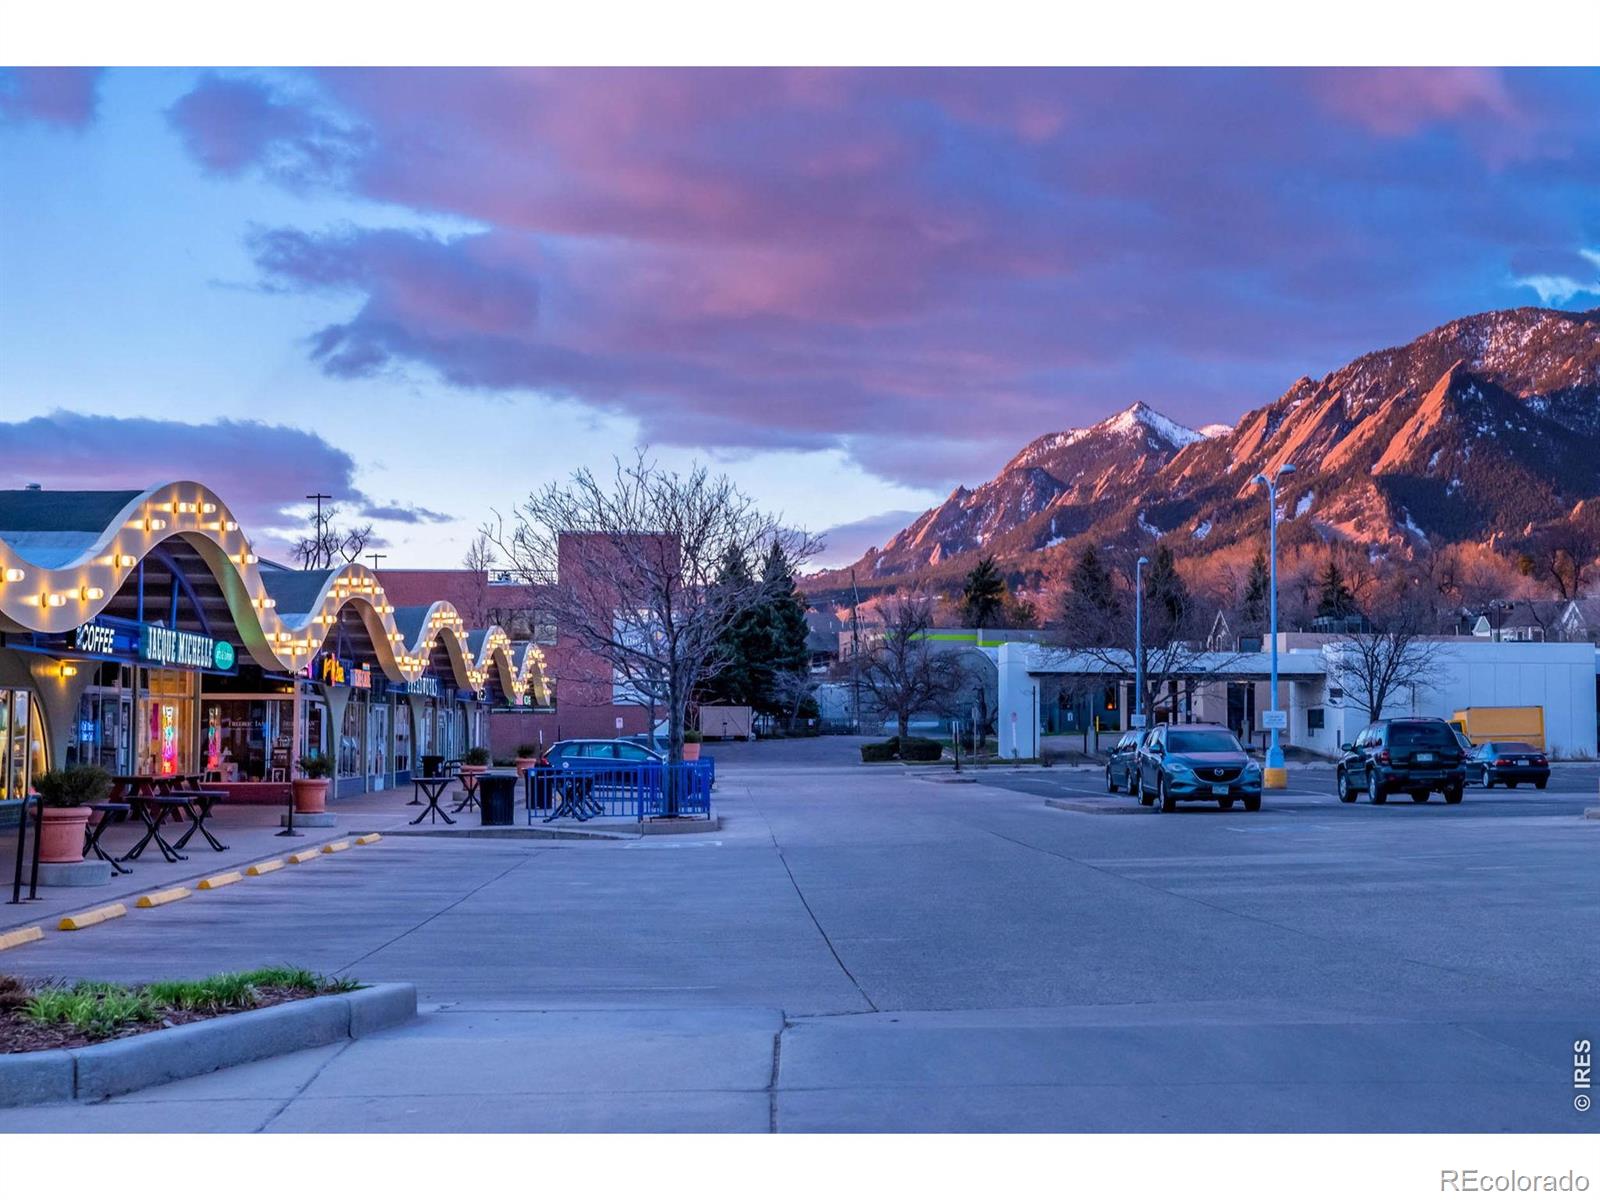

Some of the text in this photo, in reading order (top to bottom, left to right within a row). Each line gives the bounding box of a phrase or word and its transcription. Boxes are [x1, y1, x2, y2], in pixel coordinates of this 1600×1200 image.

[82, 624, 115, 653] COFFEE
[147, 626, 213, 668] JACQUE MICHELLE
